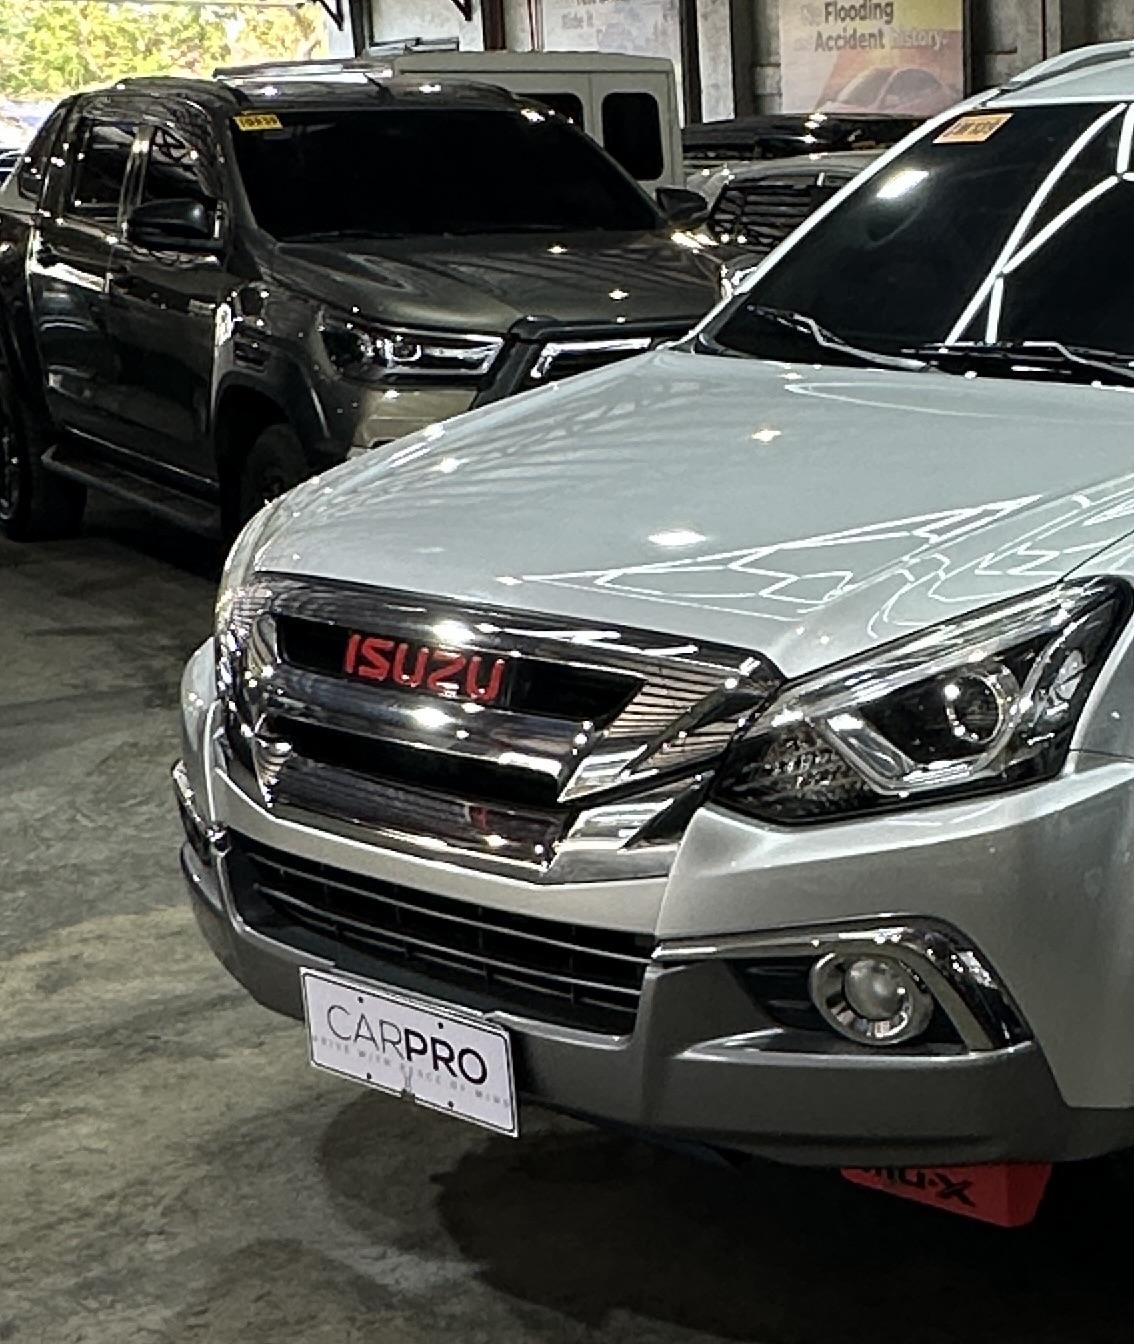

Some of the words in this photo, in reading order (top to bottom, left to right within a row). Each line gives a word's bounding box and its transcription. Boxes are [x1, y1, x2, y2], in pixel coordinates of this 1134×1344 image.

[815, 27, 885, 52] Accident
[345, 634, 506, 701] ISUZU
[326, 1004, 488, 1085] CARPRO
